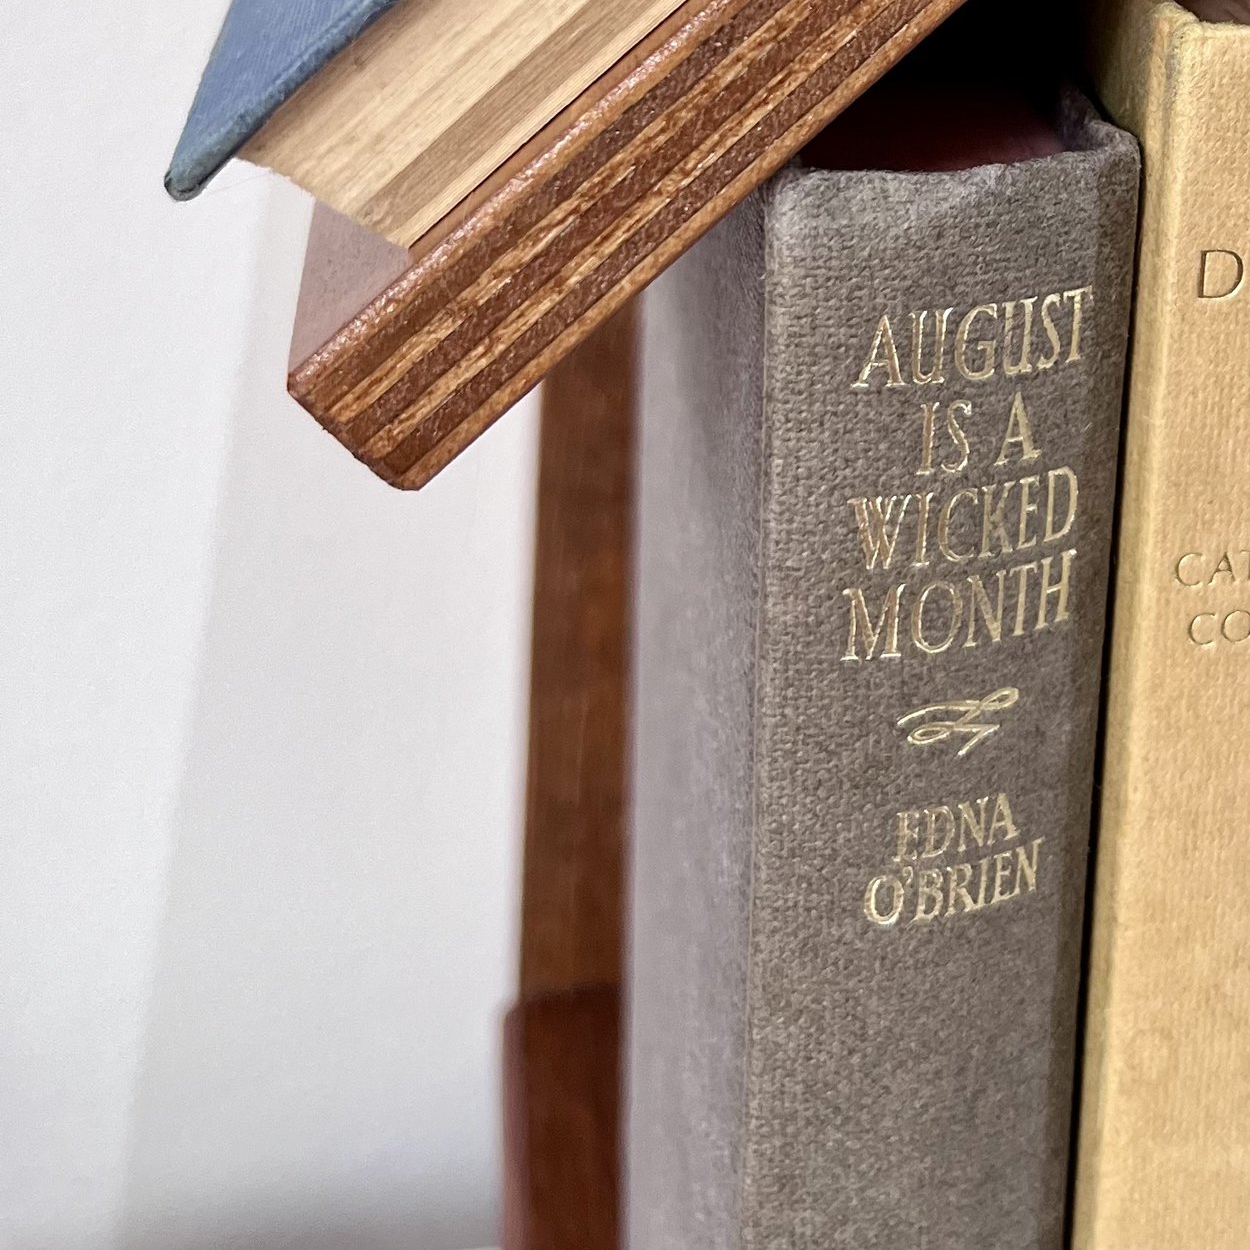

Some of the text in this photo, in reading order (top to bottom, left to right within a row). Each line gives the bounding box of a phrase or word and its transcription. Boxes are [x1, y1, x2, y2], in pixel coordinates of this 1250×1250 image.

[850, 285, 1093, 388] AUGUST
[916, 391, 1042, 476] IS A
[847, 466, 1080, 570] WICKED
[840, 549, 1077, 661] MONTH
[891, 792, 1021, 862] EDNA
[863, 836, 1045, 926] O'BRIEN
